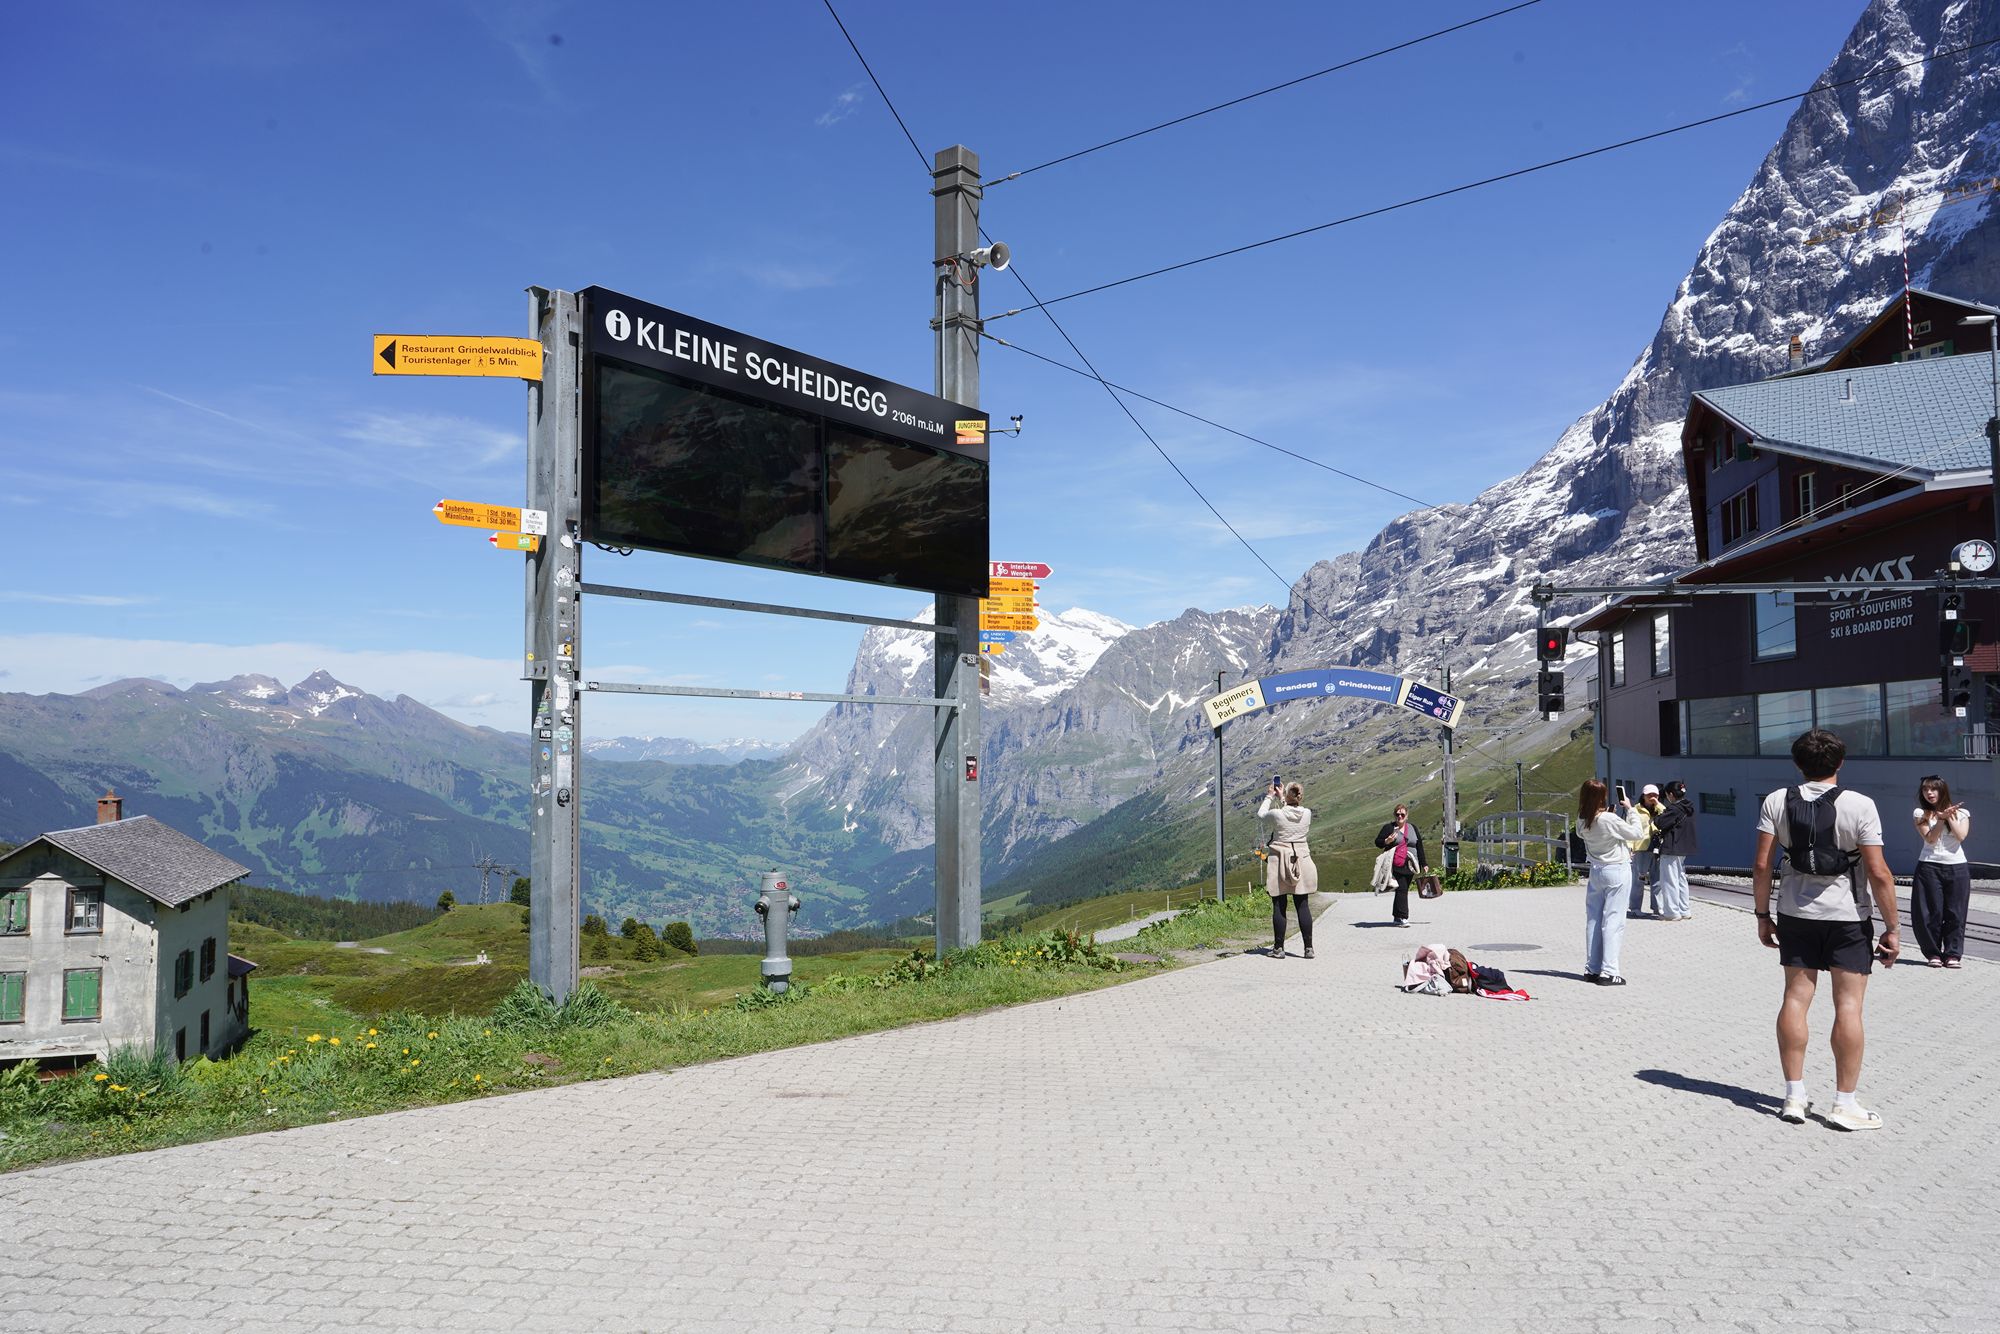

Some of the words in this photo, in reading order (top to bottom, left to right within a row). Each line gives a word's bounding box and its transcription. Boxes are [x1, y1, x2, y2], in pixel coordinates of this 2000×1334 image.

[401, 344, 455, 354] Restaurant
[457, 345, 537, 357] Grindelwaldblick
[402, 355, 471, 366] Touristenlager
[489, 357, 496, 365] 5
[498, 357, 519, 366] Min.
[637, 316, 738, 374] KLEINE
[745, 351, 888, 417] SCHEIDEGG
[892, 409, 916, 427] 2'061
[445, 504, 474, 513] Lauberhorn
[445, 511, 475, 521] Männlichen
[1010, 570, 1033, 578] Wengen
[1829, 607, 1856, 622] SPORT
[1860, 596, 1913, 617] SOUVENIRS
[1830, 626, 1844, 639] SKI
[1845, 625, 1852, 636] &
[1852, 620, 1883, 635] BOARD
[1883, 614, 1914, 630] DEPOT
[1275, 681, 1318, 693] Brandegg
[1338, 680, 1392, 692] Grindelwald
[1212, 686, 1254, 710] Beginners
[1408, 692, 1423, 703] Eiger
[1422, 697, 1434, 706] Run
[1217, 706, 1237, 720] Park
